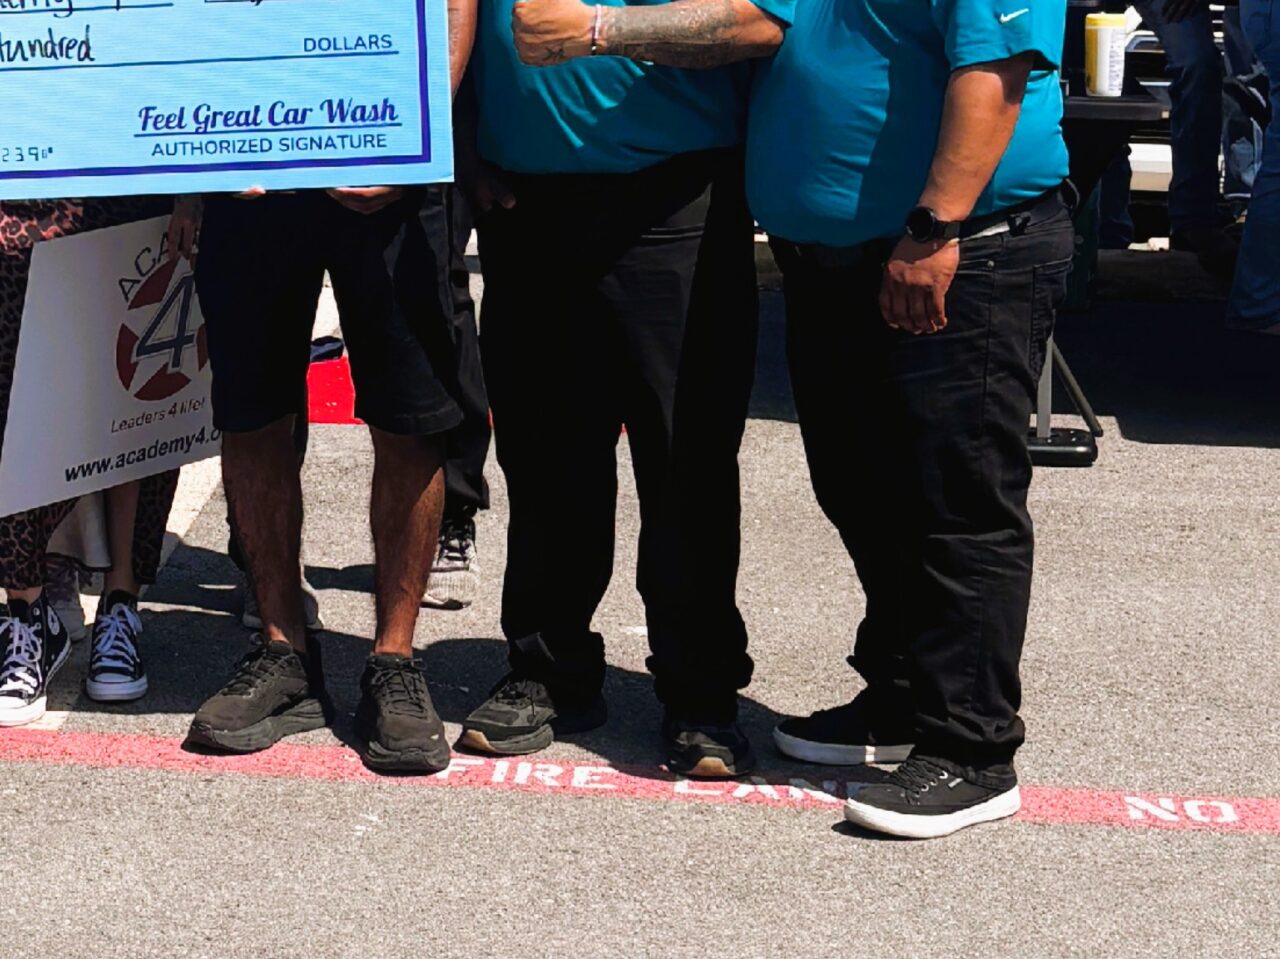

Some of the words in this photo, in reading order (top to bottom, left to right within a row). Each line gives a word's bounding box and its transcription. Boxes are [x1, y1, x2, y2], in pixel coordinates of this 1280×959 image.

[303, 34, 393, 52] DOLLARS
[138, 105, 188, 132] Feel
[193, 103, 263, 134] Great
[268, 100, 314, 127] Car
[320, 96, 399, 123] Wash
[151, 137, 274, 156] AUTHORIZED
[279, 133, 387, 152] SIGNATURE
[135, 275, 196, 370] 4
[111, 407, 167, 434] Leaders
[167, 401, 178, 418] 4
[64, 426, 222, 483] www.academy4.o
[436, 757, 620, 790] FIRE
[1123, 795, 1238, 823] NO
